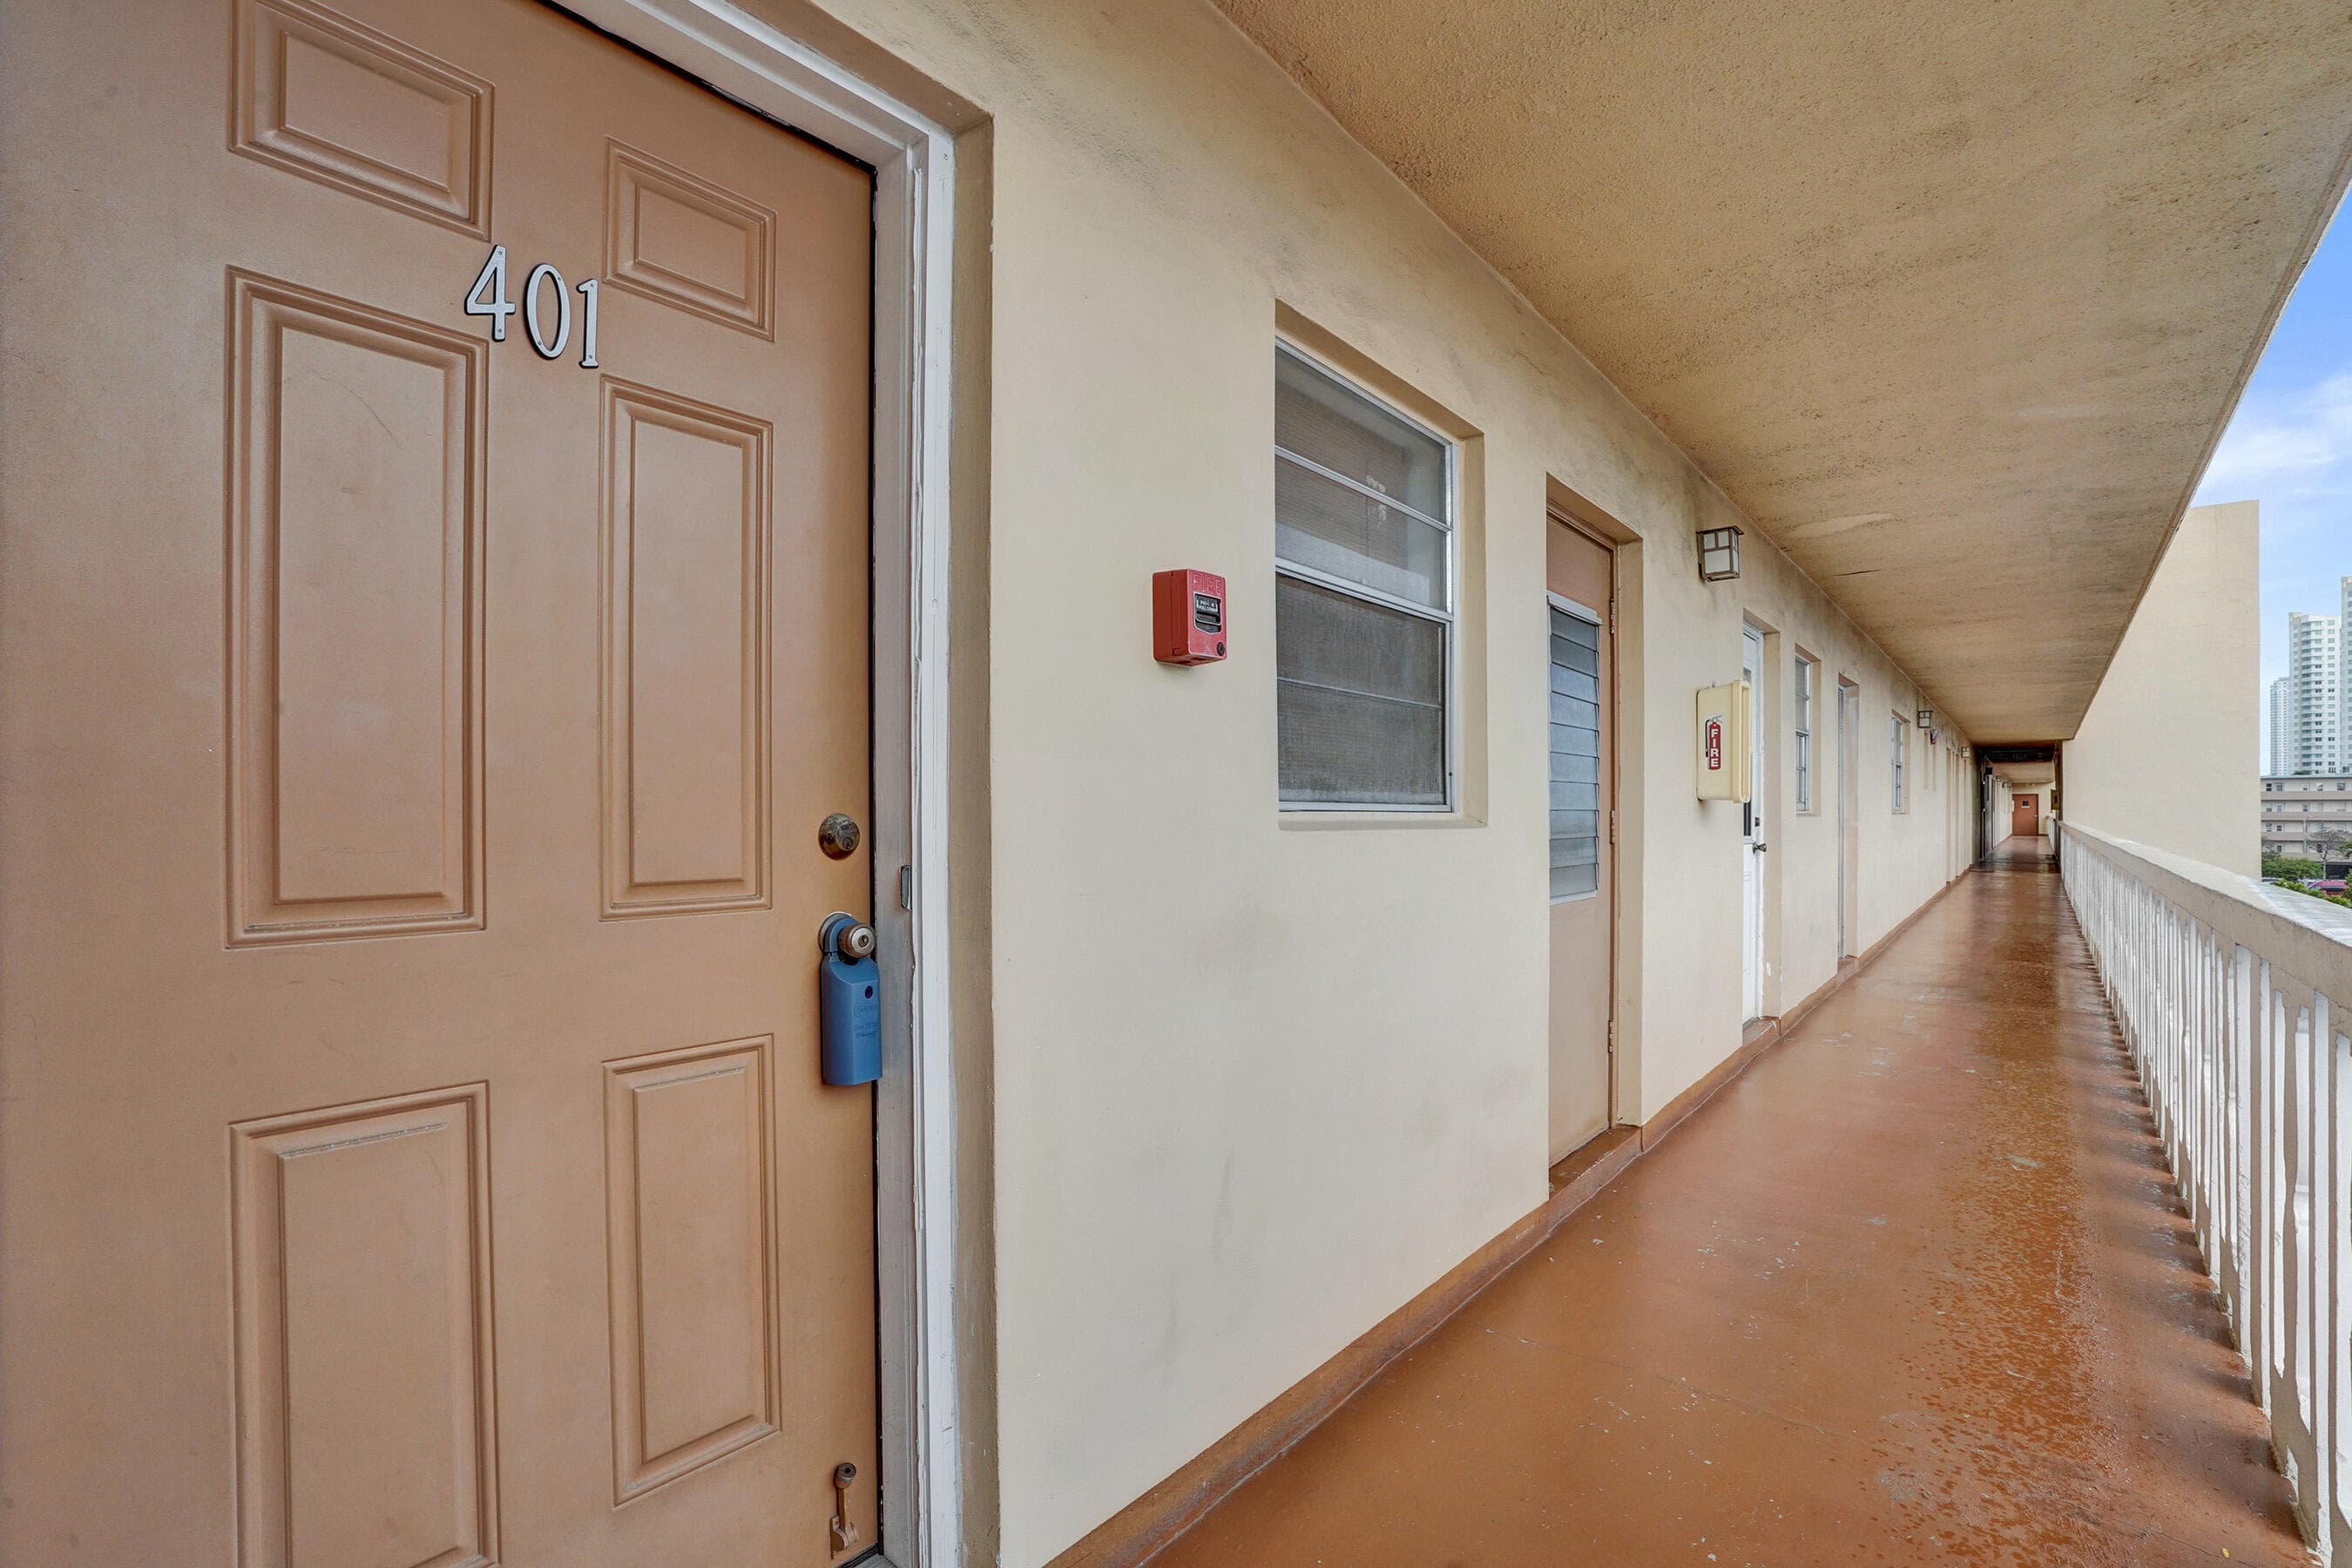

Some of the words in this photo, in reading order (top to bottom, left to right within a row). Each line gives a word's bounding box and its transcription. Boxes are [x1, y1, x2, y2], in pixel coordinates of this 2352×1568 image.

[464, 244, 599, 368] 401
[1192, 572, 1222, 596] FIRE
[1710, 728, 1719, 767] FIRE
